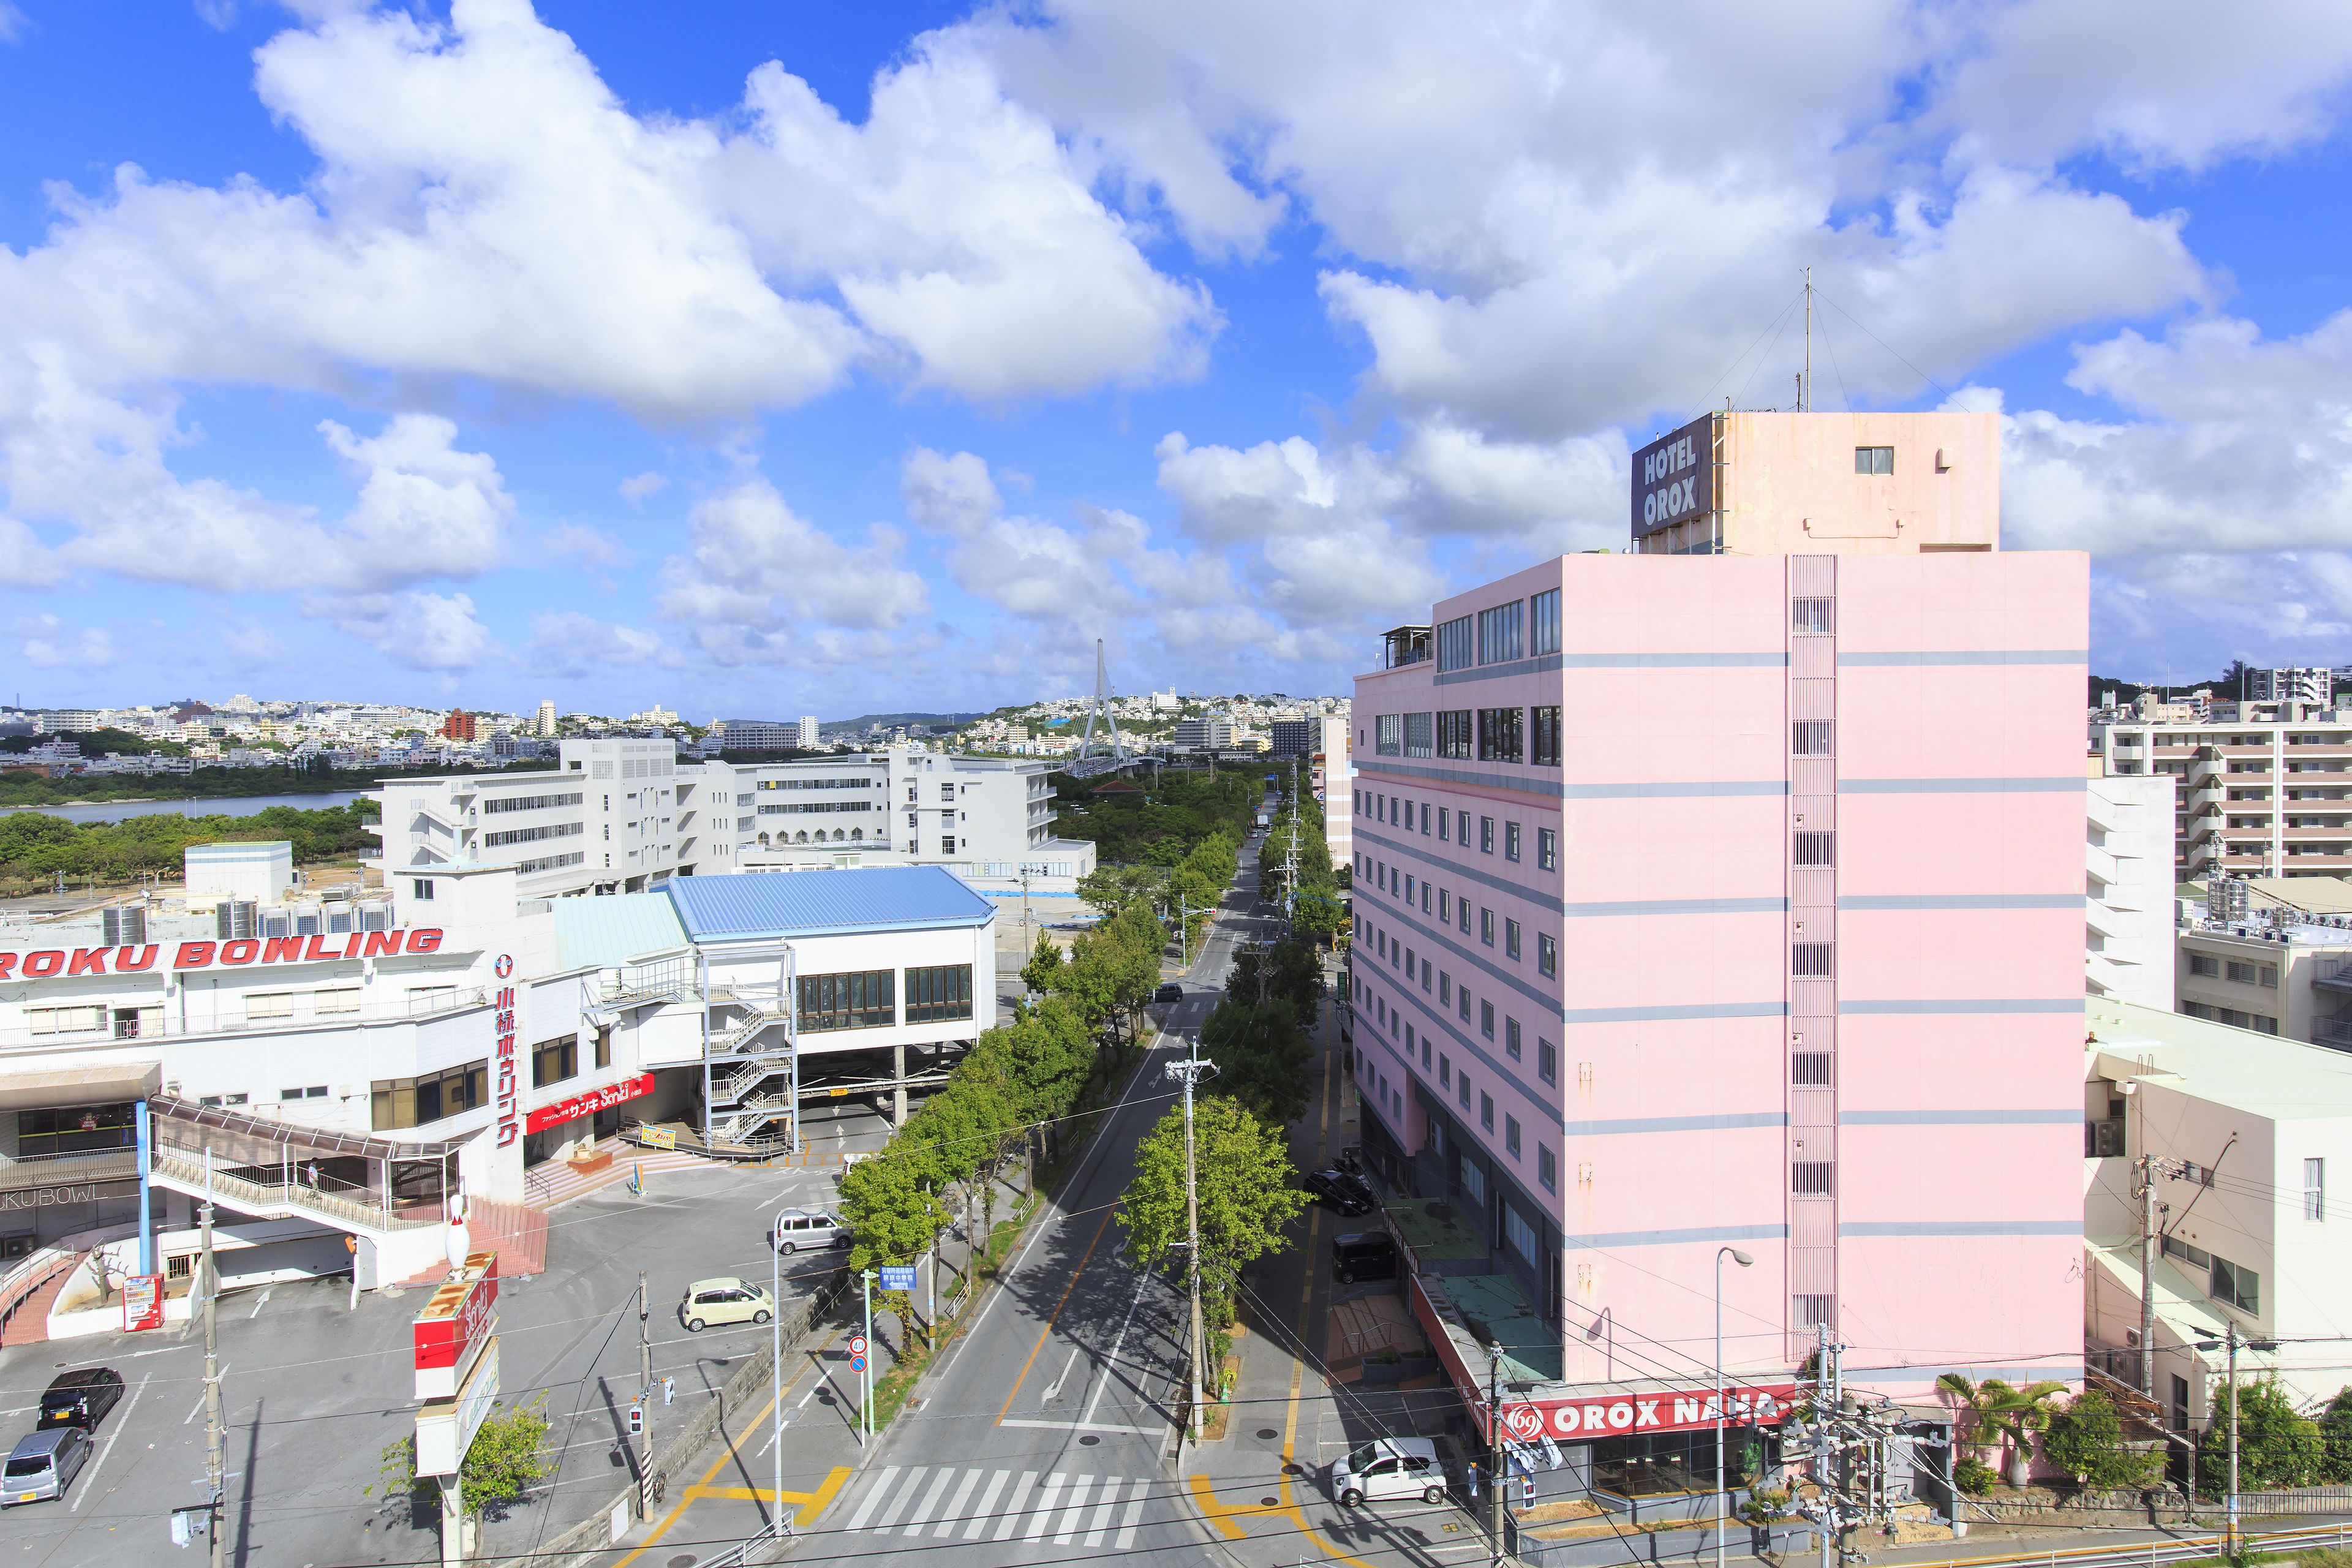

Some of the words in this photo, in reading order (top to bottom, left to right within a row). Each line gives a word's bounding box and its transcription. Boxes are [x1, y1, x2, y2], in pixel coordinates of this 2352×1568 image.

[1645, 435, 1696, 486] HOTEL
[1644, 475, 1696, 526] OROX
[173, 928, 443, 969] BOWLING
[495, 986, 519, 1150] 小禄ボウリング
[569, 1098, 598, 1118] サンキ
[0, 1184, 109, 1210] KUBOWL
[1554, 1400, 1661, 1432] OROX
[1674, 1392, 1779, 1424] NAHA
